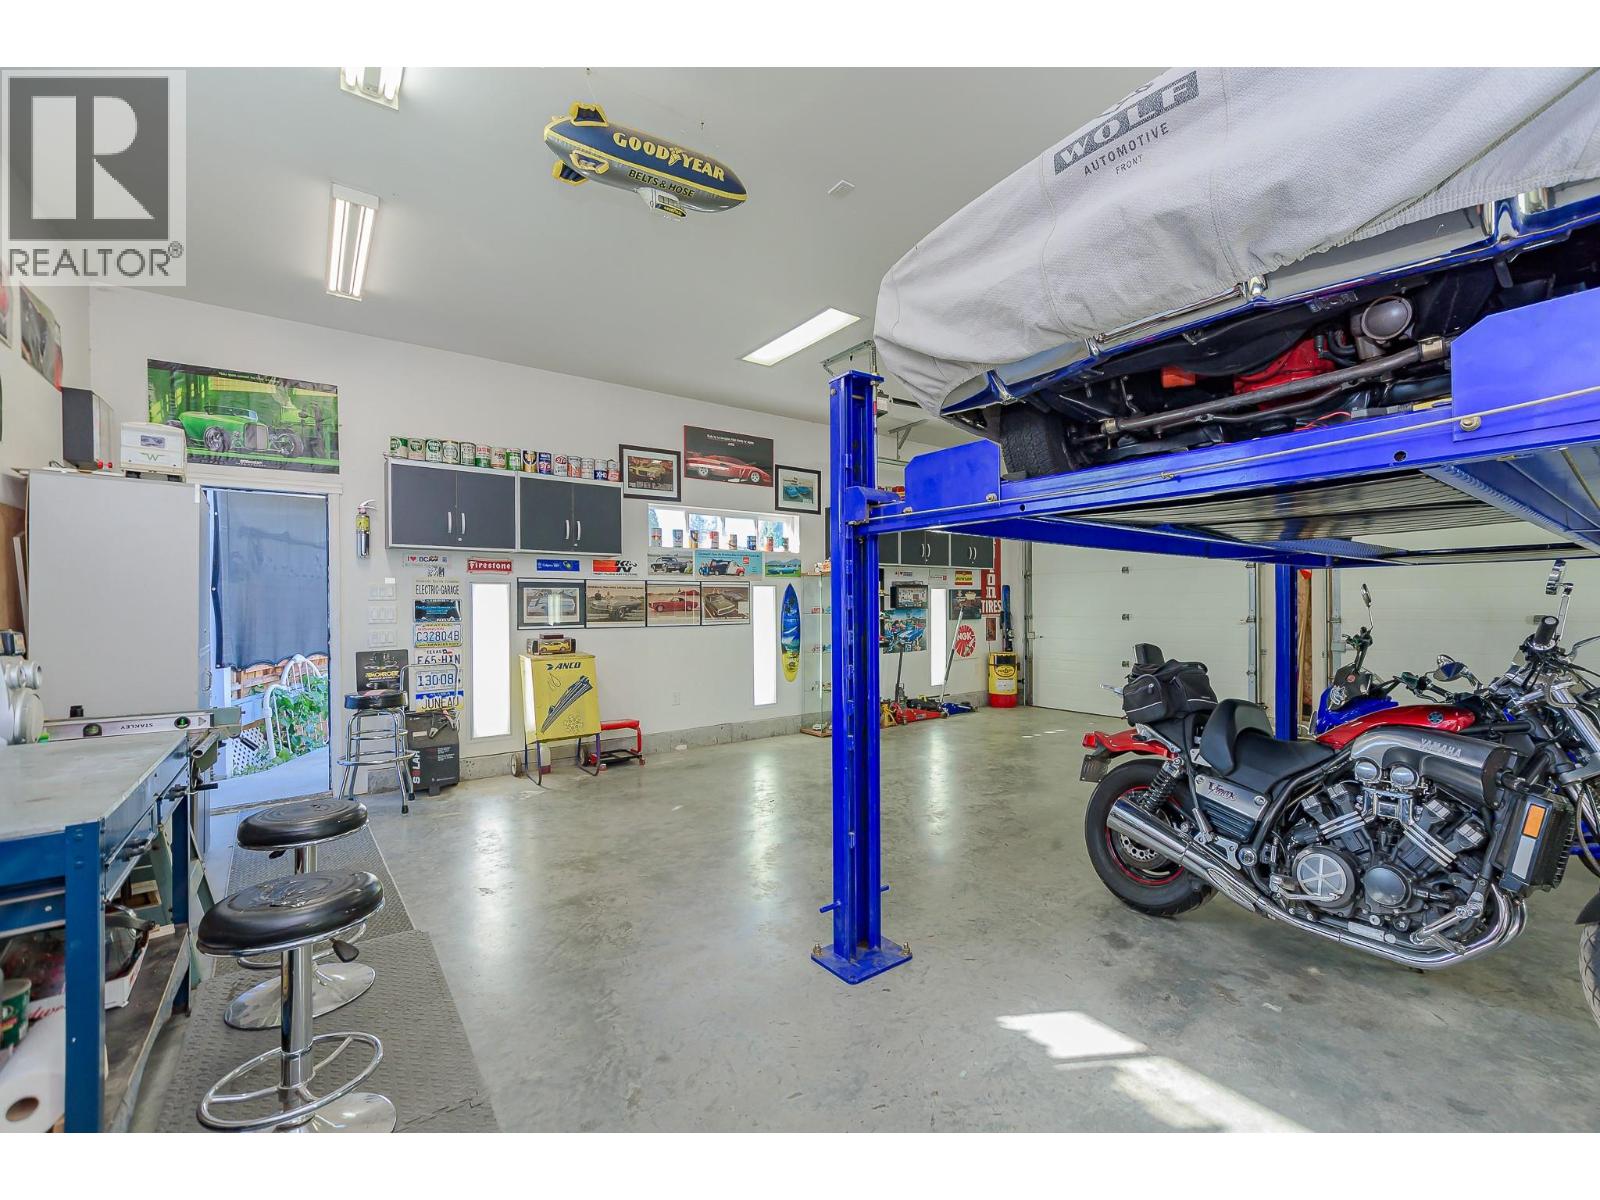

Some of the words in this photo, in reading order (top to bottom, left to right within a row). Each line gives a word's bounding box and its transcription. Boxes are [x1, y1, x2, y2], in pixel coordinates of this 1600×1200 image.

[1060, 79, 1188, 165] WOLF
[1083, 122, 1170, 176] AUTOMOTIVE
[1115, 154, 1144, 175] FRONT
[628, 169, 659, 188] BELTS
[660, 179, 668, 189] &
[668, 183, 695, 198] HOSE
[469, 561, 512, 571] Firestone
[981, 600, 1002, 614] TIRES
[555, 662, 581, 670] ANCO
[421, 696, 459, 709] JUNEAU
[120, 722, 153, 731] STANLEY
[1420, 738, 1462, 758] YAMAHA
